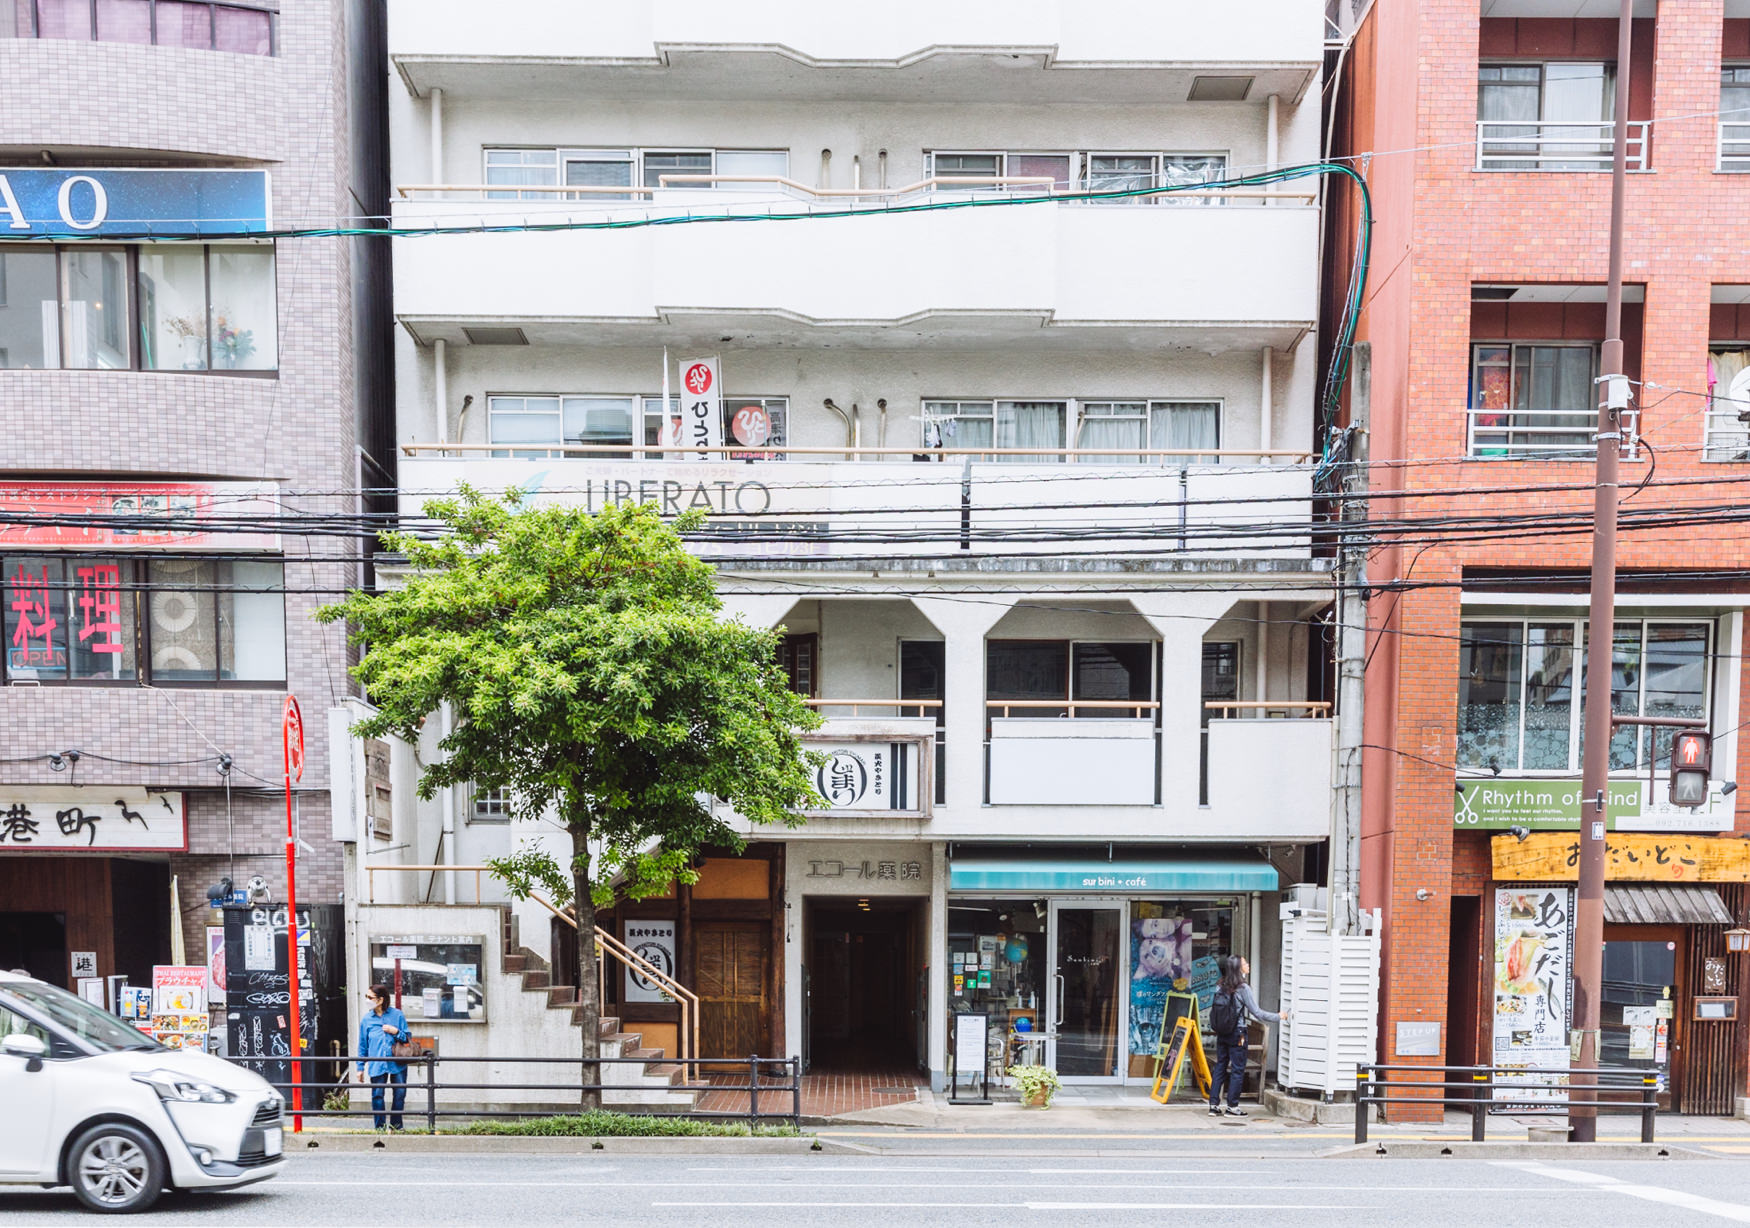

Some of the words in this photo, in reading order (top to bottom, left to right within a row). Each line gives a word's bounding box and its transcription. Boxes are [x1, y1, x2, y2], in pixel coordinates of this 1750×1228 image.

[10, 563, 124, 661] 料理
[1483, 790, 1552, 808] Rhythm
[1562, 790, 1582, 806] of
[1608, 790, 1639, 806] ind
[806, 860, 922, 881] エコール薬院
[1083, 878, 1096, 886] sur
[1098, 877, 1115, 886] bini
[1125, 877, 1147, 887] café
[1535, 892, 1566, 1020] あごだし
[1534, 994, 1546, 1034] 専門店
